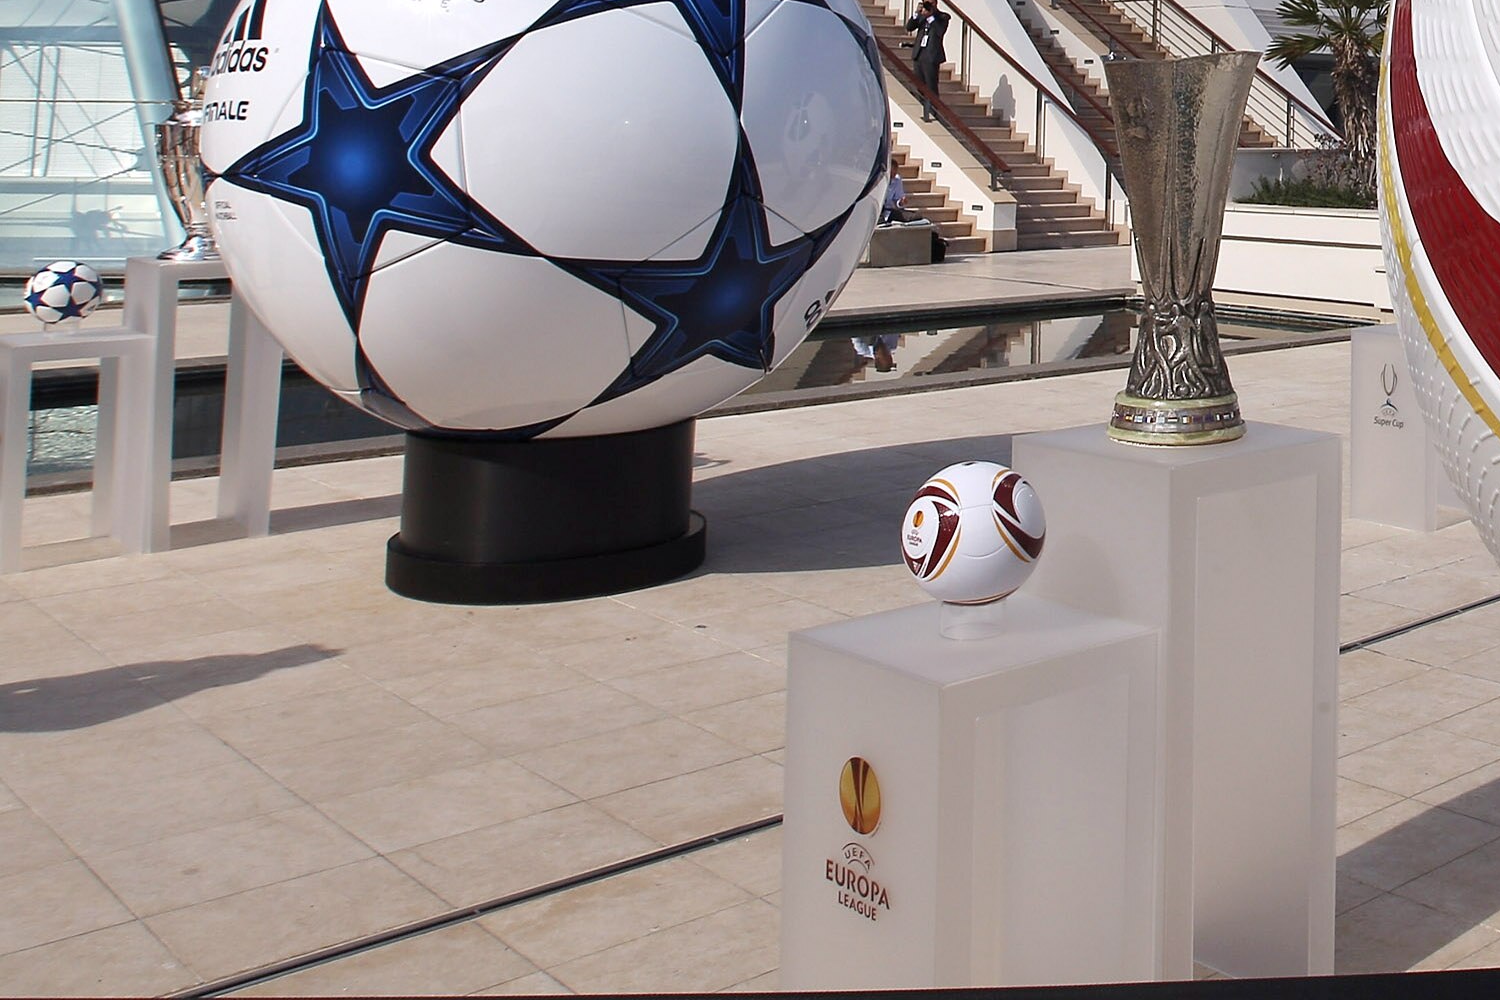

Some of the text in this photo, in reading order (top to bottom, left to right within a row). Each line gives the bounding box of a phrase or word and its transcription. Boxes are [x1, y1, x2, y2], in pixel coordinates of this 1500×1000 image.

[1373, 415, 1404, 430] Super Cup
[844, 847, 871, 870] UEFA
[825, 858, 890, 910] EUROPA
[838, 890, 877, 921] LEAGUE
